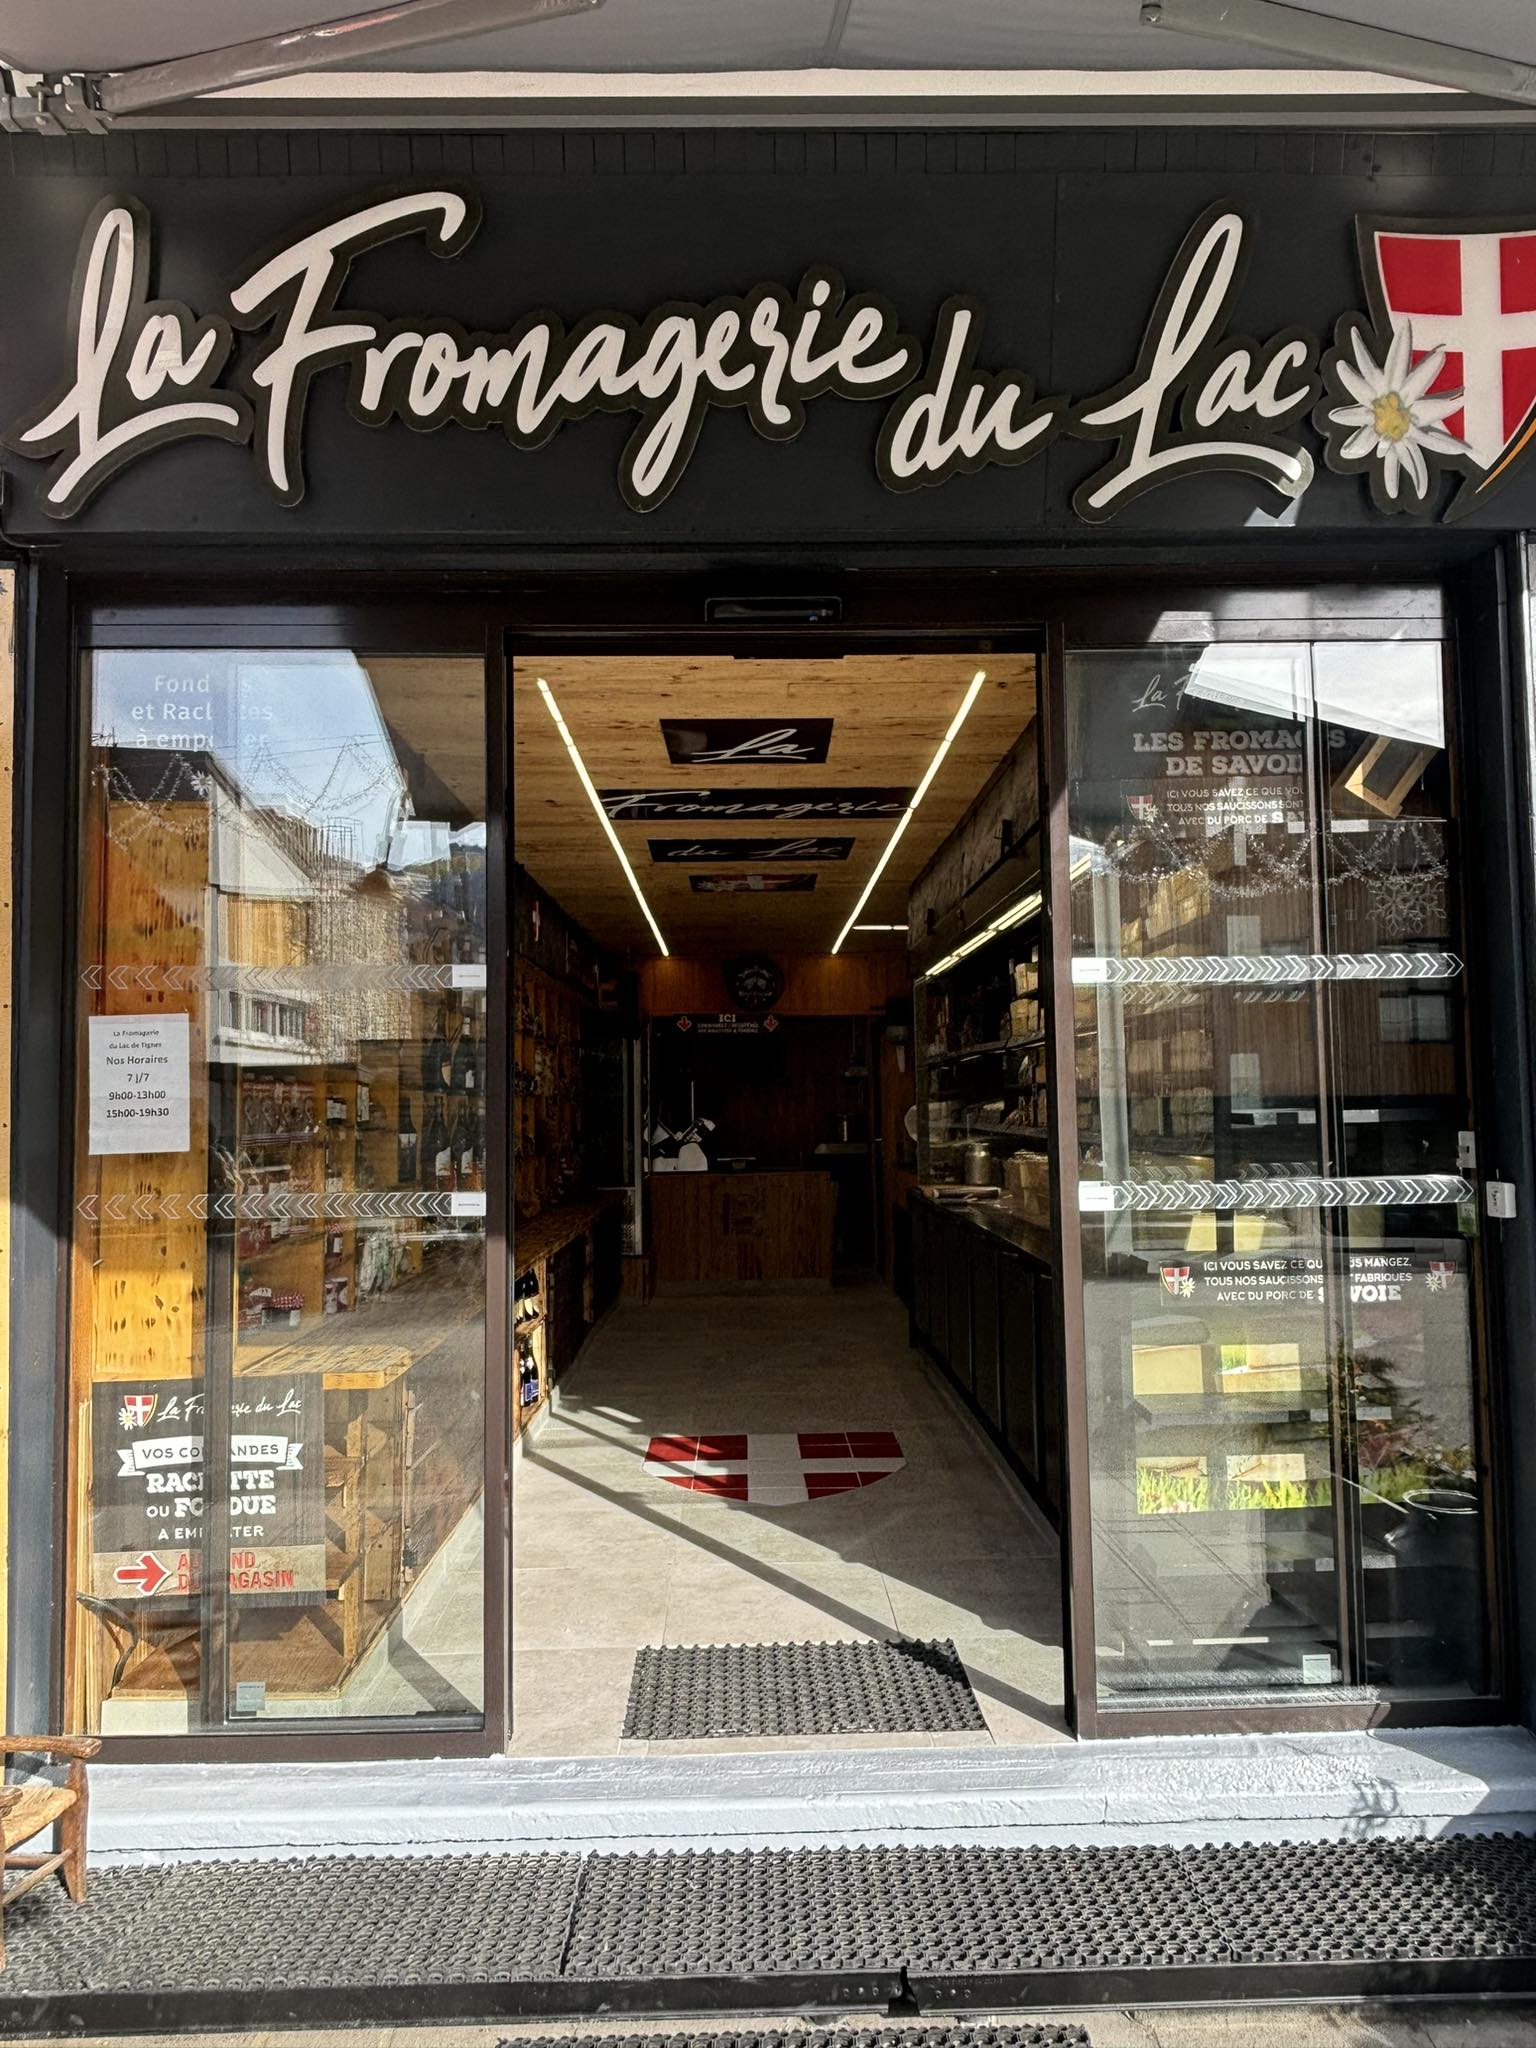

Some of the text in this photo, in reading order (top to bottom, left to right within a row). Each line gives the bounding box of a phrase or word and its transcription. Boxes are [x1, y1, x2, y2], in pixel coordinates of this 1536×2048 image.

[19, 191, 1310, 508] La Fromagerie du Lac
[691, 728, 816, 763] La
[1133, 728, 1347, 753] LES FROMAS
[1166, 754, 1303, 777] DE SAVOI
[1181, 788, 1210, 798] VOUS
[1211, 786, 1244, 797] SAVEZ
[1245, 786, 1259, 796] CE
[1261, 786, 1283, 796] QUE
[602, 790, 911, 820] Fromagerie
[1166, 802, 1194, 813] TOUS
[1194, 802, 1216, 812] NOS
[1216, 801, 1278, 812] SAUCISSONS
[1178, 817, 1205, 826] AVEC
[1206, 815, 1222, 826] DU
[1223, 815, 1252, 826] PORC
[1253, 814, 1268, 824] DE
[718, 1014, 736, 1023] ICI
[106, 1054, 168, 1065] Nos Horaires
[108, 1090, 166, 1101] 9h00-13h00
[106, 1107, 170, 1119] 15h00-19h30
[1204, 1261, 1218, 1271] ICI
[1220, 1260, 1251, 1271] VOUS
[1253, 1260, 1288, 1270] SAVEZ
[1290, 1260, 1305, 1269] CE
[1306, 1259, 1323, 1269] QU
[1204, 1276, 1233, 1286] TOUS
[1235, 1276, 1257, 1286] NOS
[1258, 1274, 1324, 1285] SAUCISSONS
[1217, 1290, 1245, 1301] AVEC
[1248, 1290, 1263, 1300] DU
[1265, 1290, 1297, 1300] PORC
[1299, 1289, 1314, 1300] DE
[157, 1396, 181, 1422] La
[255, 1396, 274, 1413] du
[276, 1388, 302, 1417] Lac
[142, 1444, 280, 1459] VOS CONDES
[146, 1470, 275, 1493] RACTTE
[146, 1494, 277, 1518] OU FODUE
[158, 1525, 265, 1540] A EMTER
